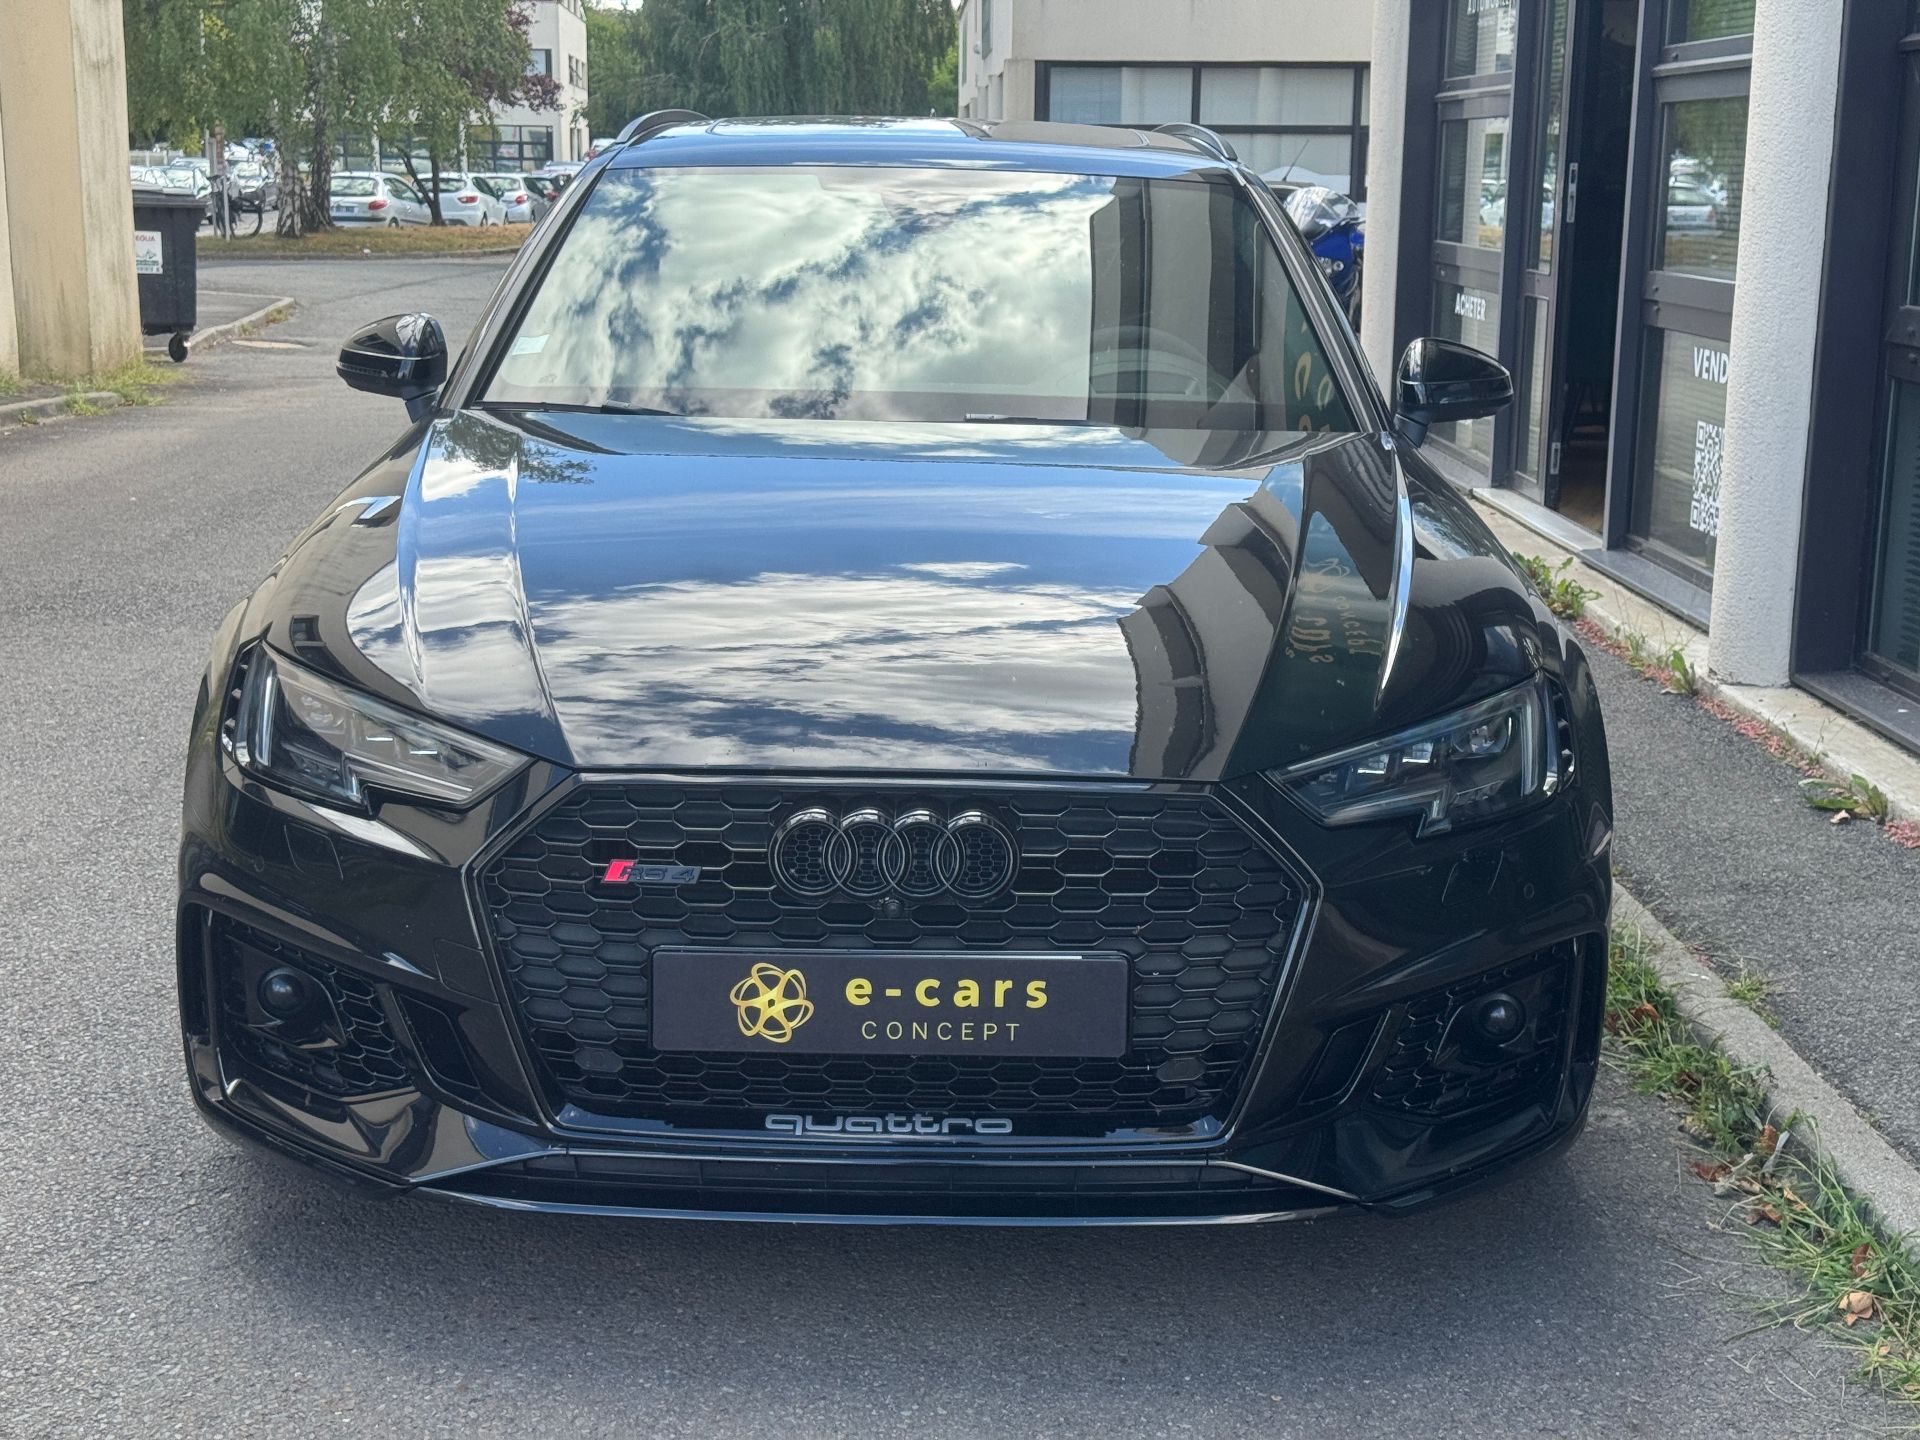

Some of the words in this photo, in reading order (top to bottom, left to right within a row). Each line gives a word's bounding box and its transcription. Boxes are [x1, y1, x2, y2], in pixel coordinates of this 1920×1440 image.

[1455, 293, 1486, 321] ACHETER
[846, 977, 1049, 1009] e-cars
[861, 1020, 1021, 1042] CONCEPT
[765, 1112, 1014, 1136] quattro
